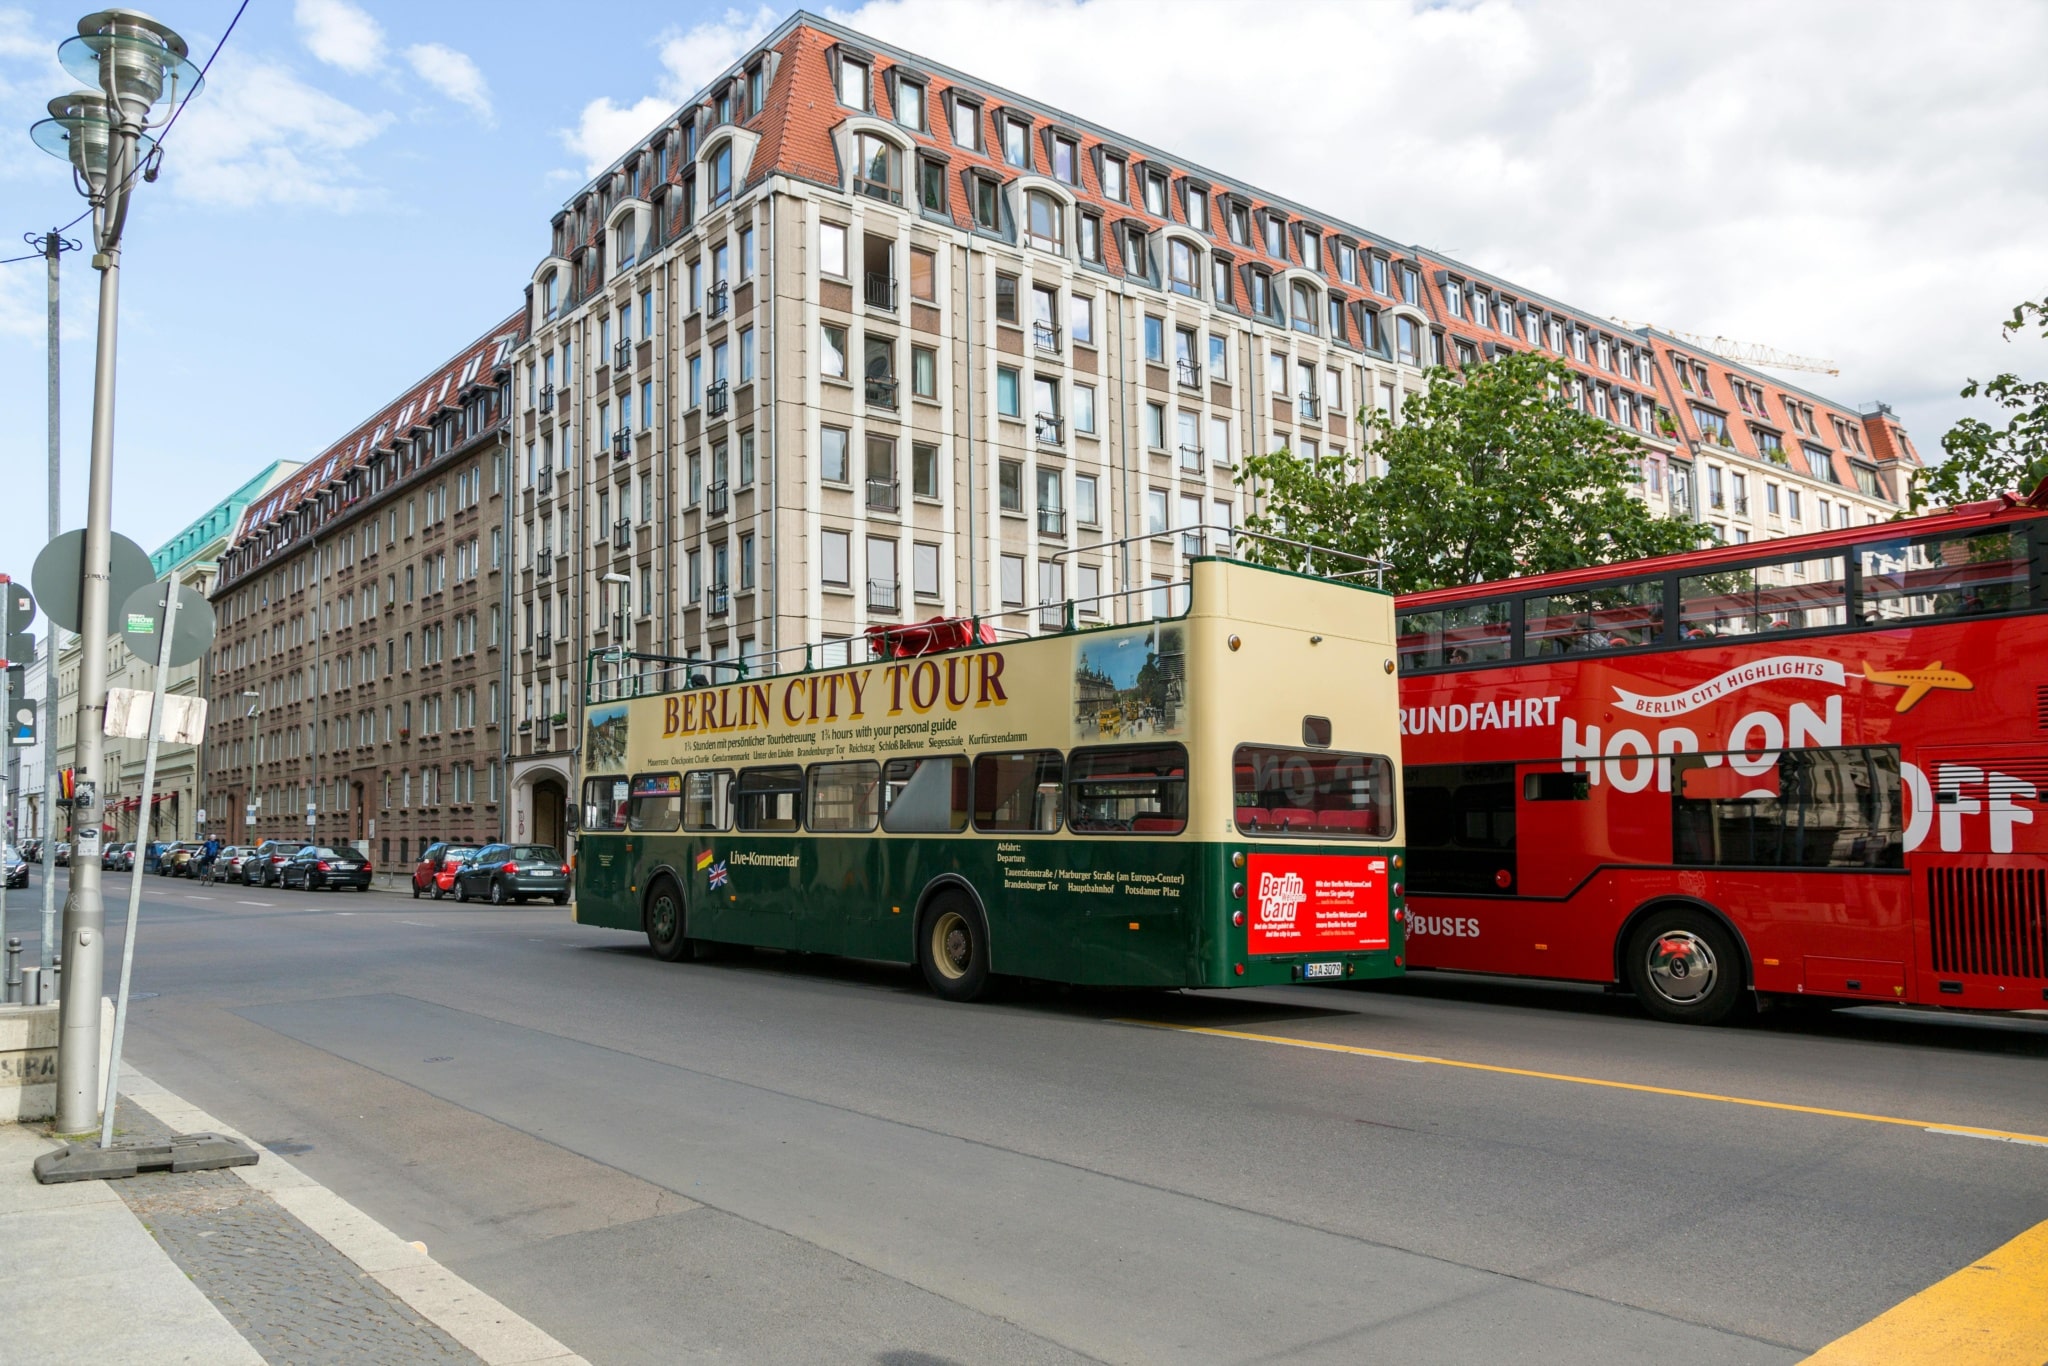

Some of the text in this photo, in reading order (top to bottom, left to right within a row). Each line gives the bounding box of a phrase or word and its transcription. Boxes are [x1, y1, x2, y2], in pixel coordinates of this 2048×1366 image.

[662, 651, 1008, 739] BERLIN CITY TOUR
[1635, 662, 1824, 714] BERLIN CITY HIGHLIGHTS
[1399, 696, 1561, 735] RUNDFAHRT
[693, 740, 716, 751] Stunden
[717, 739, 727, 749] mit
[728, 736, 766, 751] persönlicher
[767, 733, 816, 745] Tourbetreuung
[832, 728, 853, 740] hours
[855, 726, 872, 738] with
[873, 726, 892, 739] your
[894, 720, 930, 738] personal
[931, 718, 957, 735] guide
[768, 750, 777, 758] den
[778, 748, 794, 758] Linden
[797, 746, 835, 756] Brandenburger
[835, 744, 845, 754] Tor
[848, 743, 875, 753] Reichstag
[879, 740, 899, 751] Schloß
[900, 739, 924, 749] Bellevue
[928, 736, 963, 748] Siegessäule
[968, 732, 1028, 745] Kurfürstendamm
[997, 842, 1021, 852] Abfahrt:
[730, 850, 800, 867] Live-Kommentar
[997, 854, 1025, 863] Departure
[1004, 880, 1180, 897] Brandenburger Tor Hauptbahnhof Potsdamer Platz
[1058, 870, 1091, 880] Marburger
[1093, 872, 1114, 881] Straße
[1116, 872, 1129, 882] (am
[1131, 873, 1184, 885] Europa-Center)
[1261, 874, 1302, 897] Berlin
[1264, 897, 1296, 918] Card
[1414, 916, 1480, 938] BUSES
